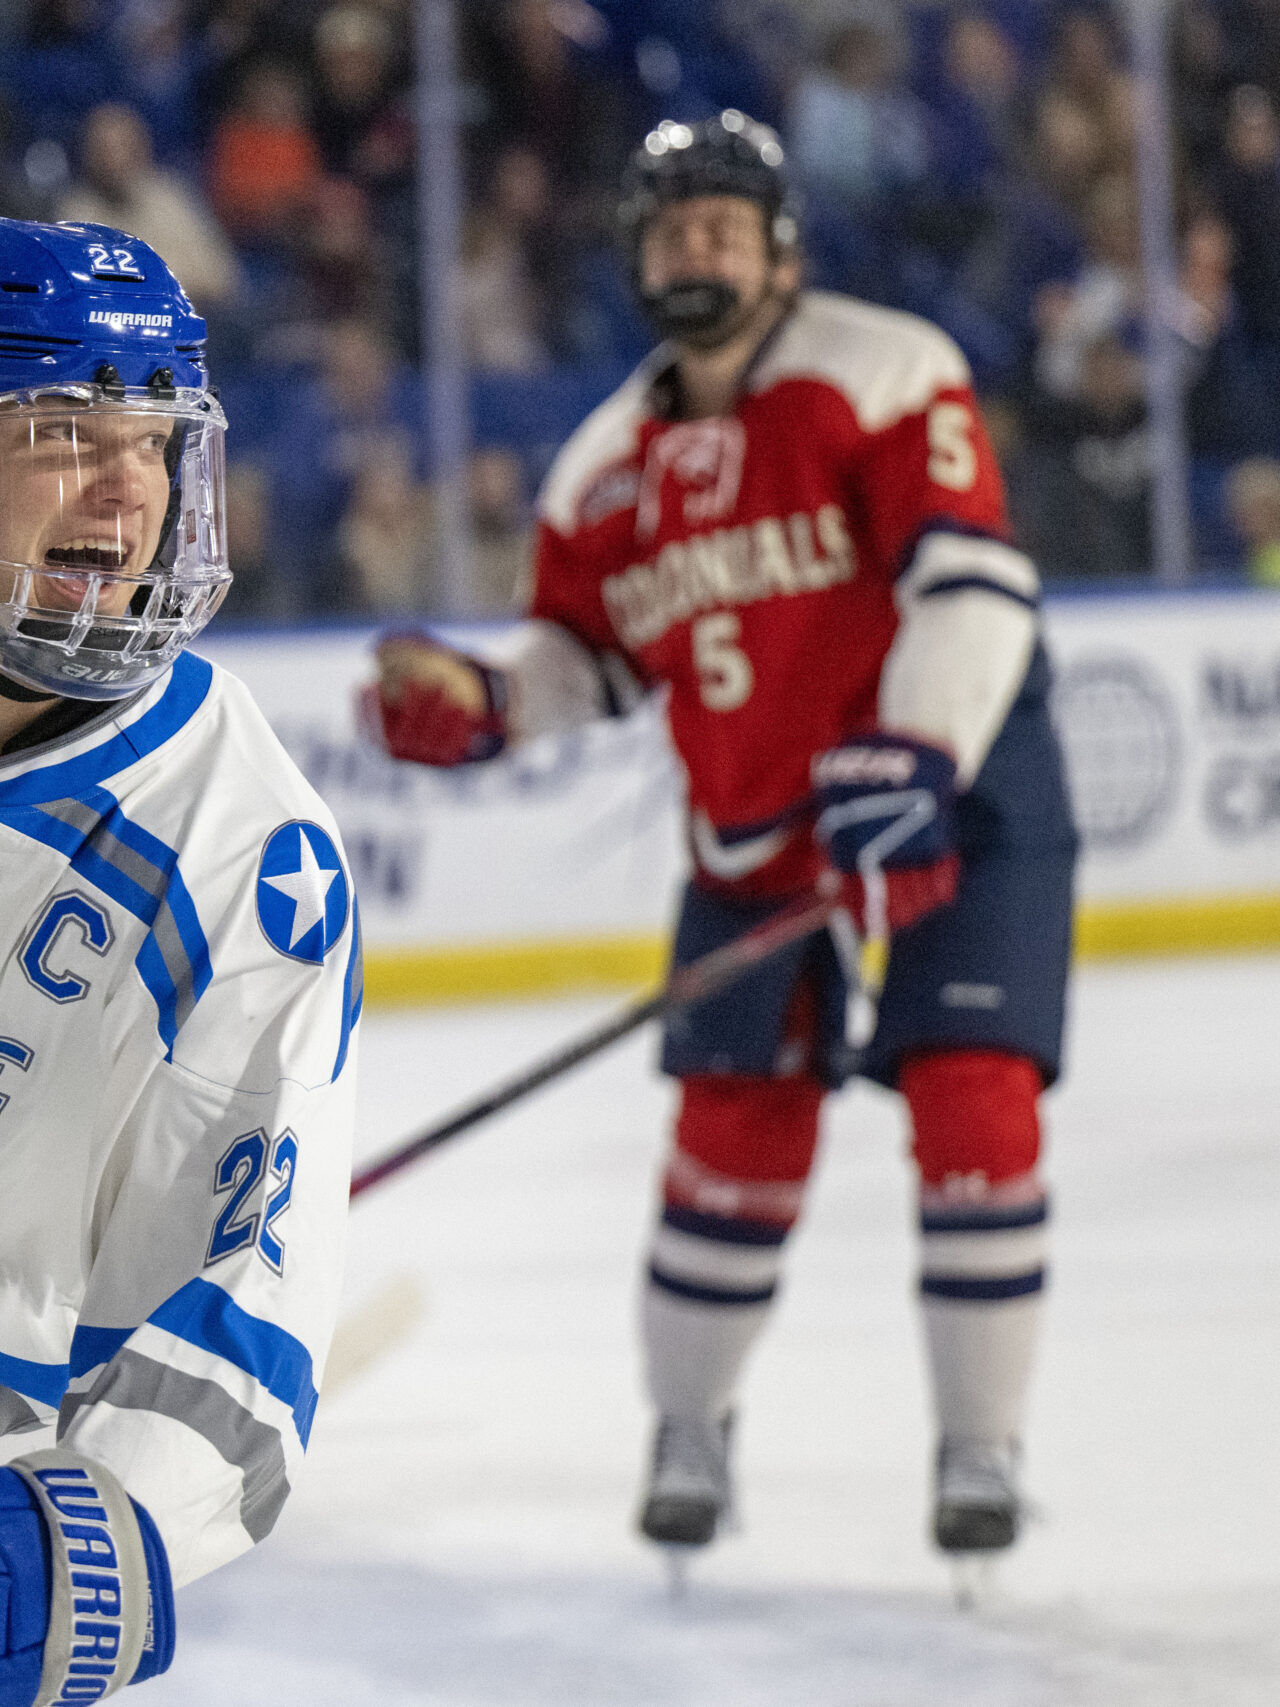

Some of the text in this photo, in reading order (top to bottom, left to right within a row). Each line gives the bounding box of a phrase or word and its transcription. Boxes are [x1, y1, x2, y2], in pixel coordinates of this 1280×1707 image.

[87, 246, 140, 273] 22
[88, 310, 173, 328] WARRIOR
[927, 407, 977, 493] 5
[691, 612, 755, 713] 5
[17, 888, 115, 1005] C
[203, 1125, 299, 1280] 22
[32, 1466, 123, 1707] WARRIO
